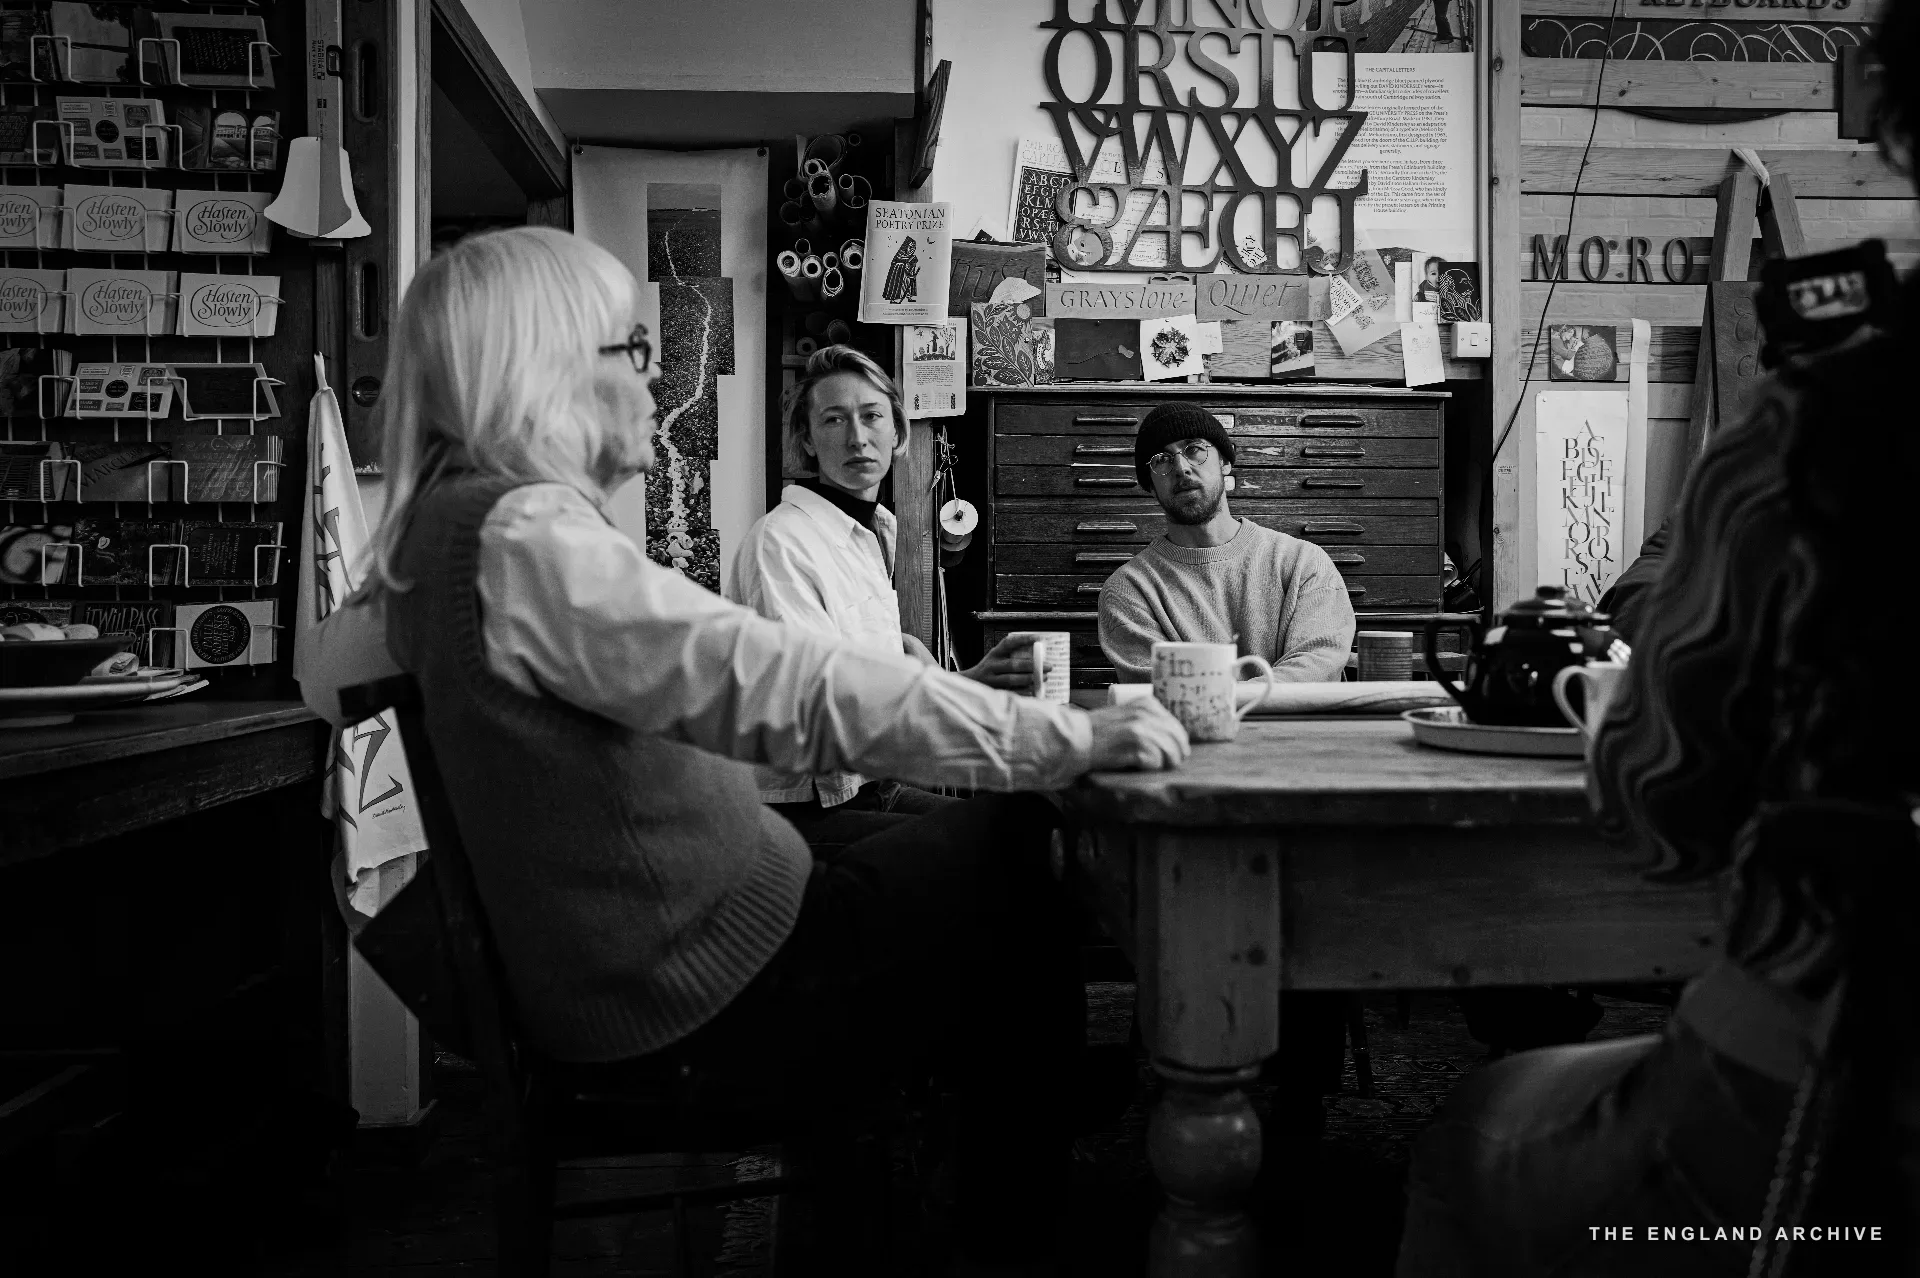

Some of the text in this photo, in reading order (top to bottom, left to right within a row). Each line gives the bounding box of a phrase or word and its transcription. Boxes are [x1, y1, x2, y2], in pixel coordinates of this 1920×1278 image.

[875, 206, 945, 220] SEATONIAN
[876, 219, 944, 230] POETRY PRIZE
[1209, 278, 1302, 316] Quiet
